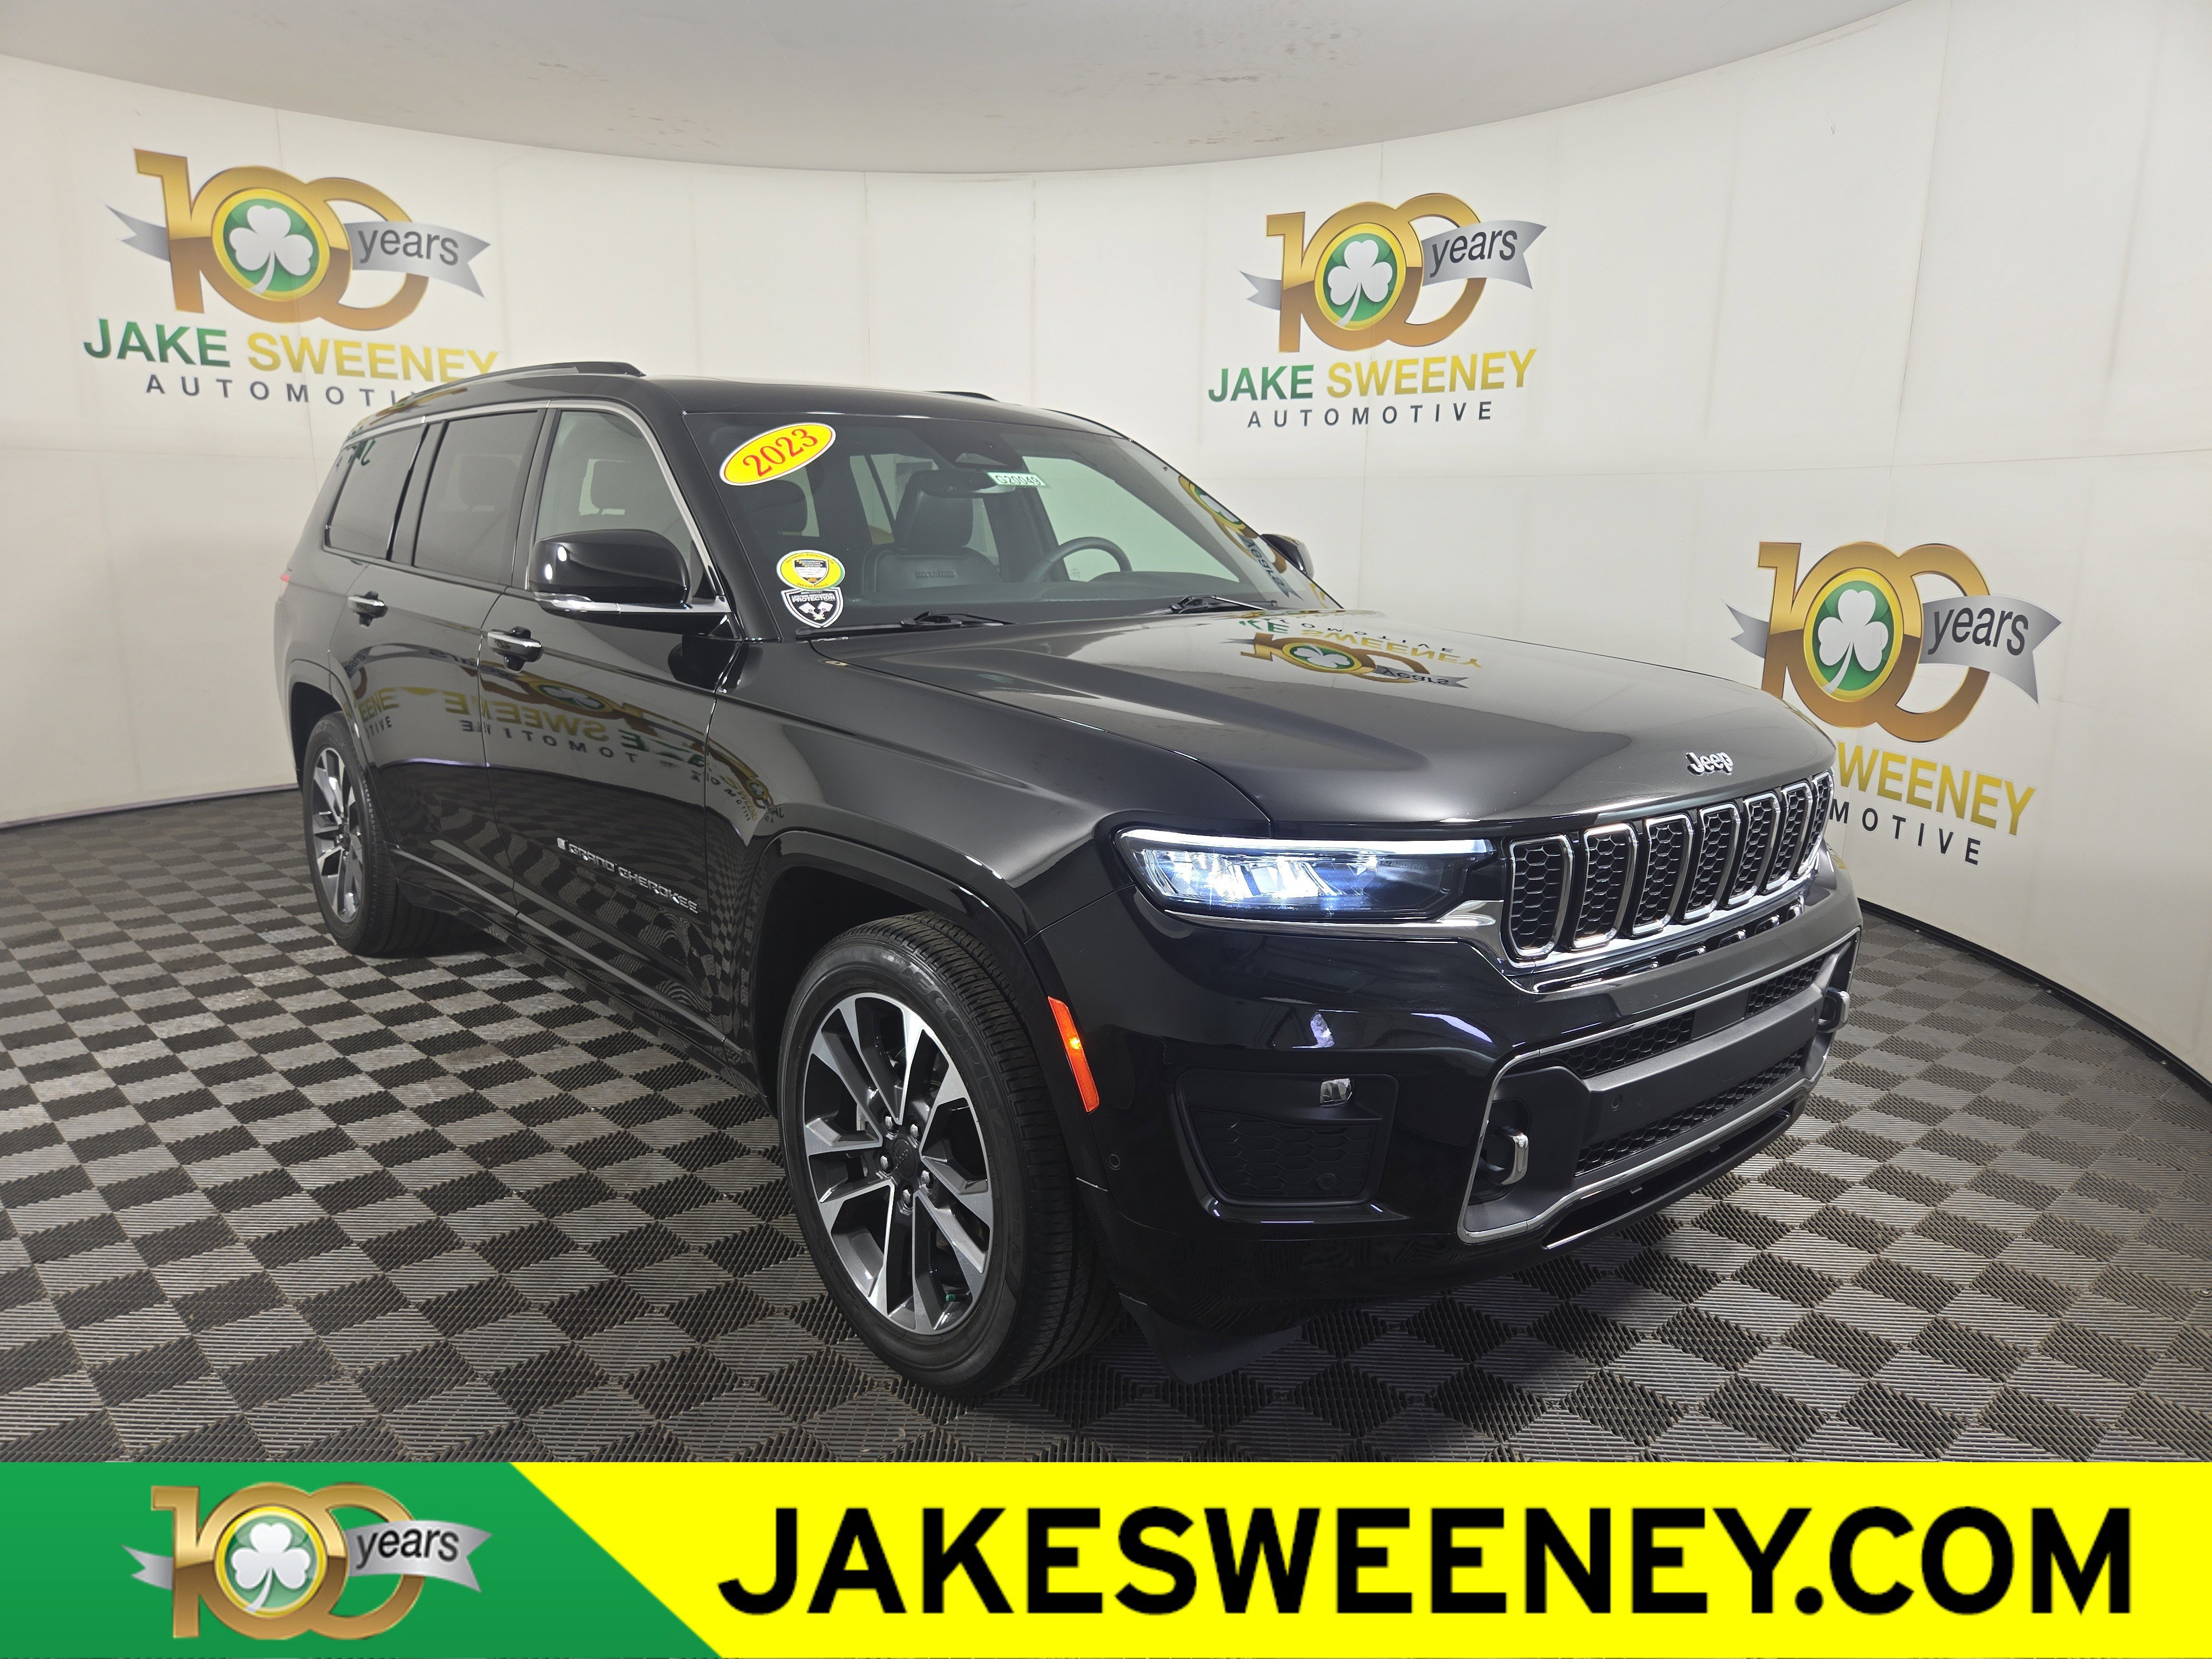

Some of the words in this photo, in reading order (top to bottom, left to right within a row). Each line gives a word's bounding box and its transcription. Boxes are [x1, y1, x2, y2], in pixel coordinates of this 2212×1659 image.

[358, 228, 460, 266] years
[1430, 229, 1518, 278] years
[83, 318, 231, 368] JAKE
[247, 332, 499, 384] SWEENEY
[1208, 364, 1315, 403] JAKE
[1326, 348, 1538, 398] SWEENEY
[146, 374, 416, 408] AUTOMOTI
[1248, 401, 1492, 428] AUTOMOTIVE
[742, 428, 819, 477] 2023
[1928, 607, 2029, 656] years
[1684, 752, 1733, 776] Jeep
[1837, 741, 2037, 836] WEENEY
[1829, 798, 1981, 865] MOTIVE
[569, 843, 615, 872] GRAND
[618, 866, 699, 914] CHEROKEE
